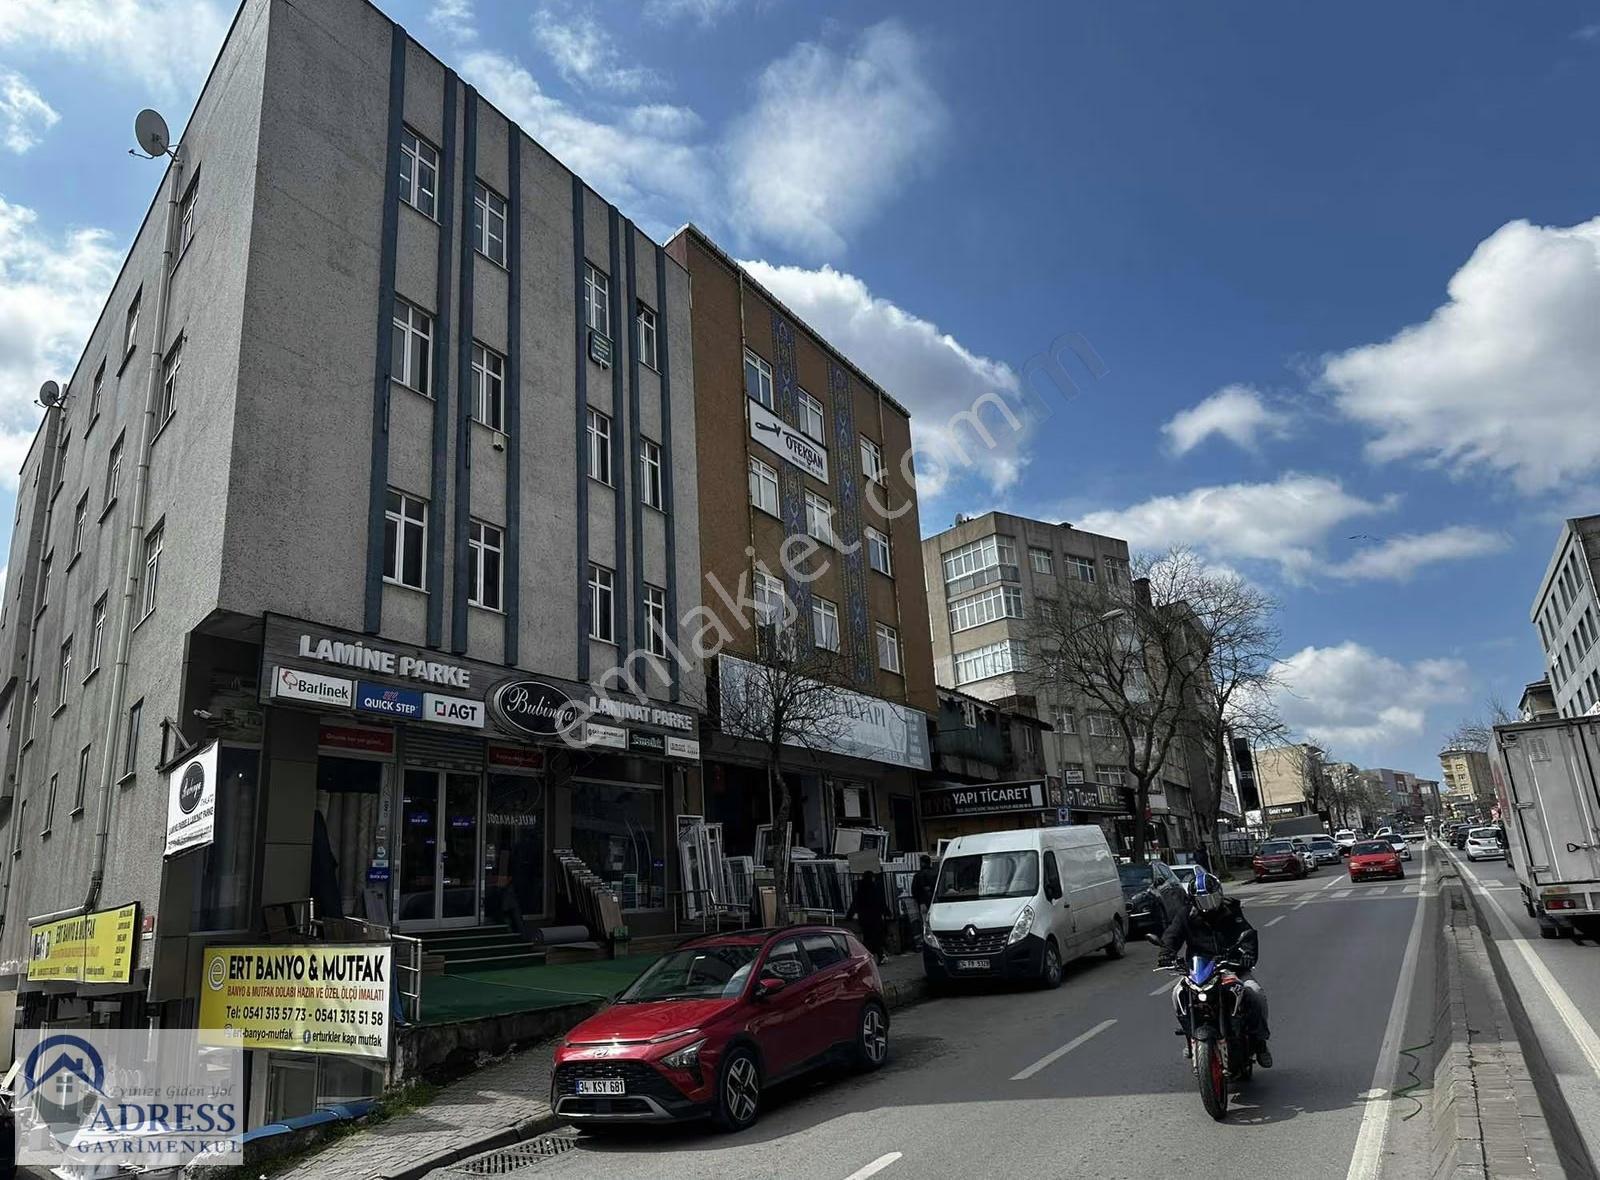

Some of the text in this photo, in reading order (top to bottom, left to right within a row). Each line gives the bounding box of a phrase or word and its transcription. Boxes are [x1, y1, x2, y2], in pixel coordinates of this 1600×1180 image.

[299, 634, 471, 689] LAMİNE PARKE
[298, 680, 349, 700] Barlinek
[364, 697, 394, 712] QUICK
[395, 703, 416, 714] STEP
[448, 703, 477, 721] AGT
[506, 686, 574, 729] Bubinga
[651, 707, 693, 731] PARKE
[952, 789, 978, 806] YAPI
[981, 787, 1029, 803] TİCARET
[228, 954, 384, 982] ERT BANYO & MUTFAK
[227, 985, 384, 1002] BANYO & MUTFAK DOLABI HAZIR VE ÖZEL ÖLÇÜ İMALATI
[226, 1005, 241, 1019] Tel:
[243, 1006, 264, 1019] 0541
[265, 1007, 280, 1019] 313
[281, 1007, 293, 1020] 57
[295, 1008, 306, 1021] 73
[314, 1008, 338, 1023] 0541
[339, 1010, 356, 1024] 313
[358, 1011, 368, 1024] 51
[371, 1012, 383, 1026] 58
[358, 1035, 382, 1047] mutfak
[580, 1081, 588, 1092] 34
[592, 1081, 606, 1092] KSY
